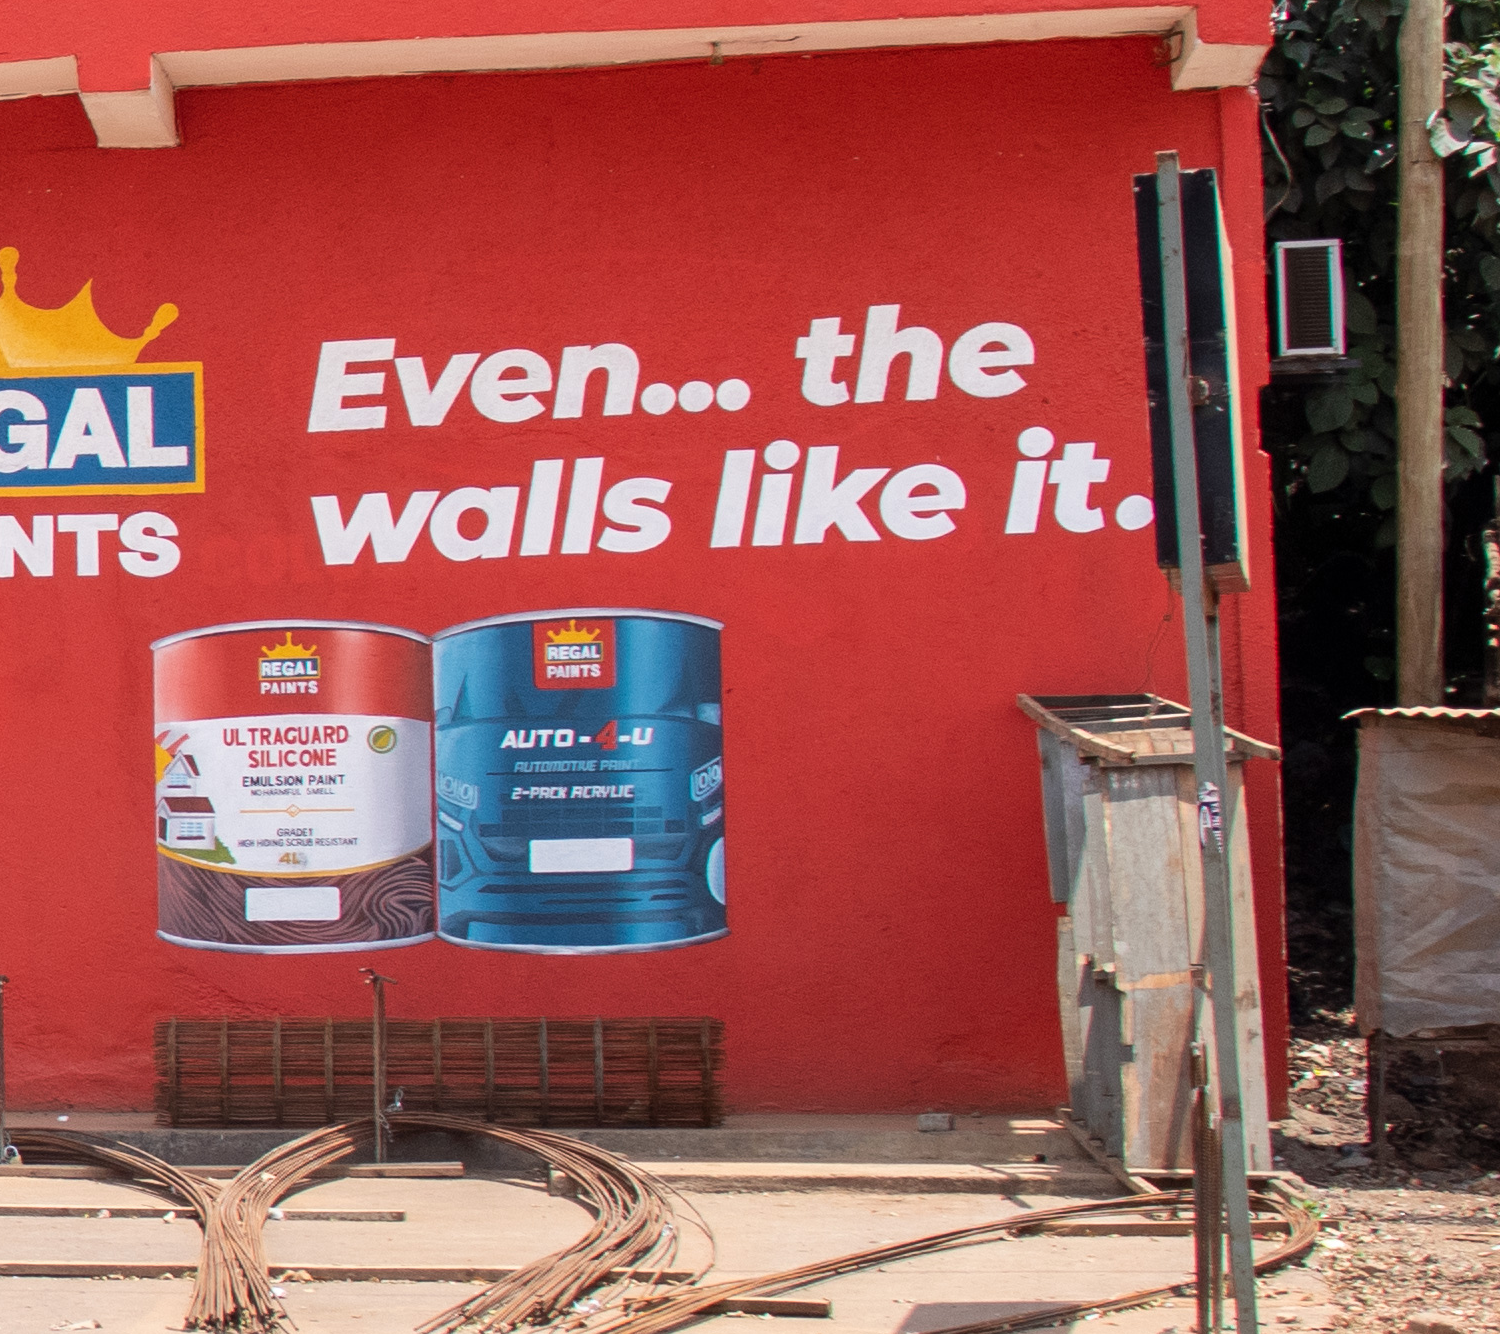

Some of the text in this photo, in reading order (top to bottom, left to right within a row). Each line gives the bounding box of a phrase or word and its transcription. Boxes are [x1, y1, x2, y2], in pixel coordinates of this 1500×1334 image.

[307, 304, 1035, 434] Even... the
[310, 426, 1155, 566] walls like it.
[547, 643, 601, 662] REGAL
[261, 659, 318, 678] REGAL
[546, 663, 601, 679] PAINTS
[260, 680, 318, 695] PAINTS
[223, 725, 349, 747] ULTRAGUARD
[248, 749, 337, 768] SILICONE
[514, 759, 640, 773] AUTOMOTIVE PAINT
[242, 774, 346, 788] EMULSION PAINT
[307, 788, 335, 796] SMELL
[511, 785, 635, 800] 2-PACK ACRYLIC
[257, 839, 284, 847] HIDING
[286, 838, 313, 847] SCRUB
[315, 837, 358, 847] RESISTANT
